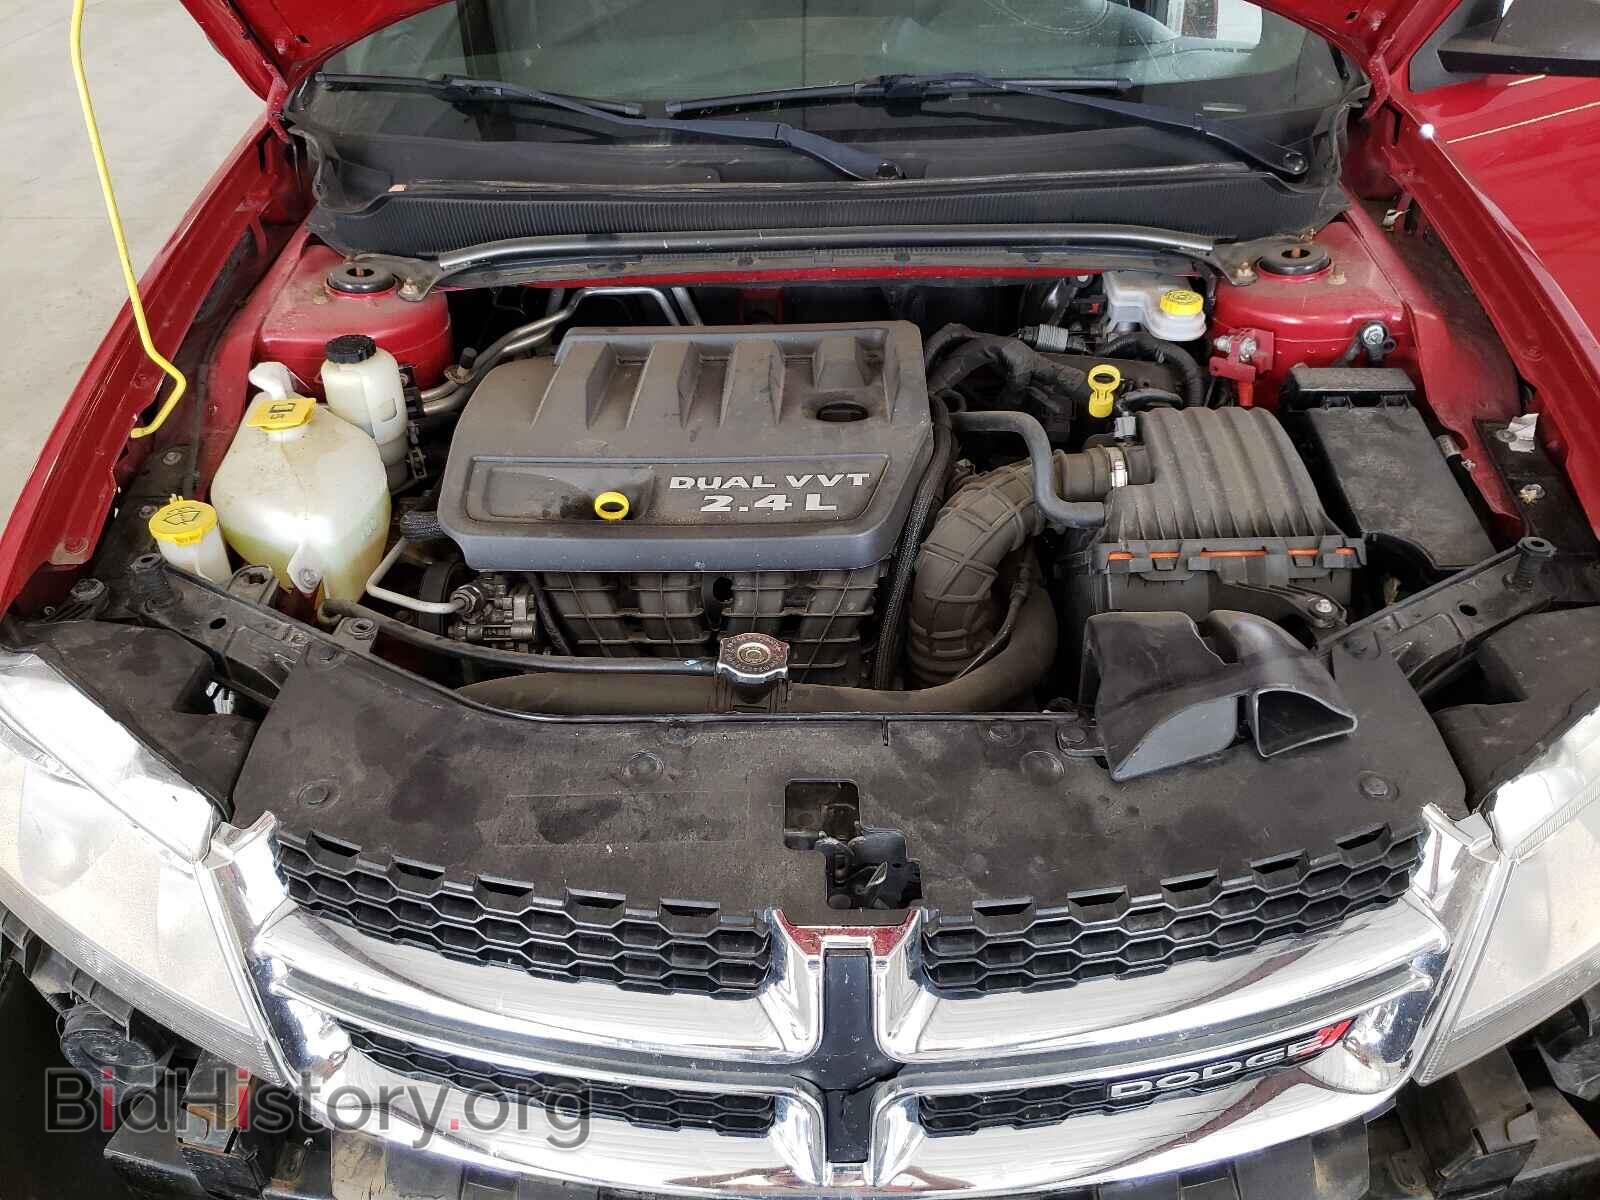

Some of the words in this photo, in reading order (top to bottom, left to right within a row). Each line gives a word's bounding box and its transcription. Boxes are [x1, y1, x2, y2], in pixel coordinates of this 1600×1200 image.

[669, 475, 776, 490] DUAL
[785, 473, 870, 488] VVT
[700, 493, 793, 512] 2.4
[805, 493, 837, 511] L
[1109, 1034, 1327, 1099] DODGE
